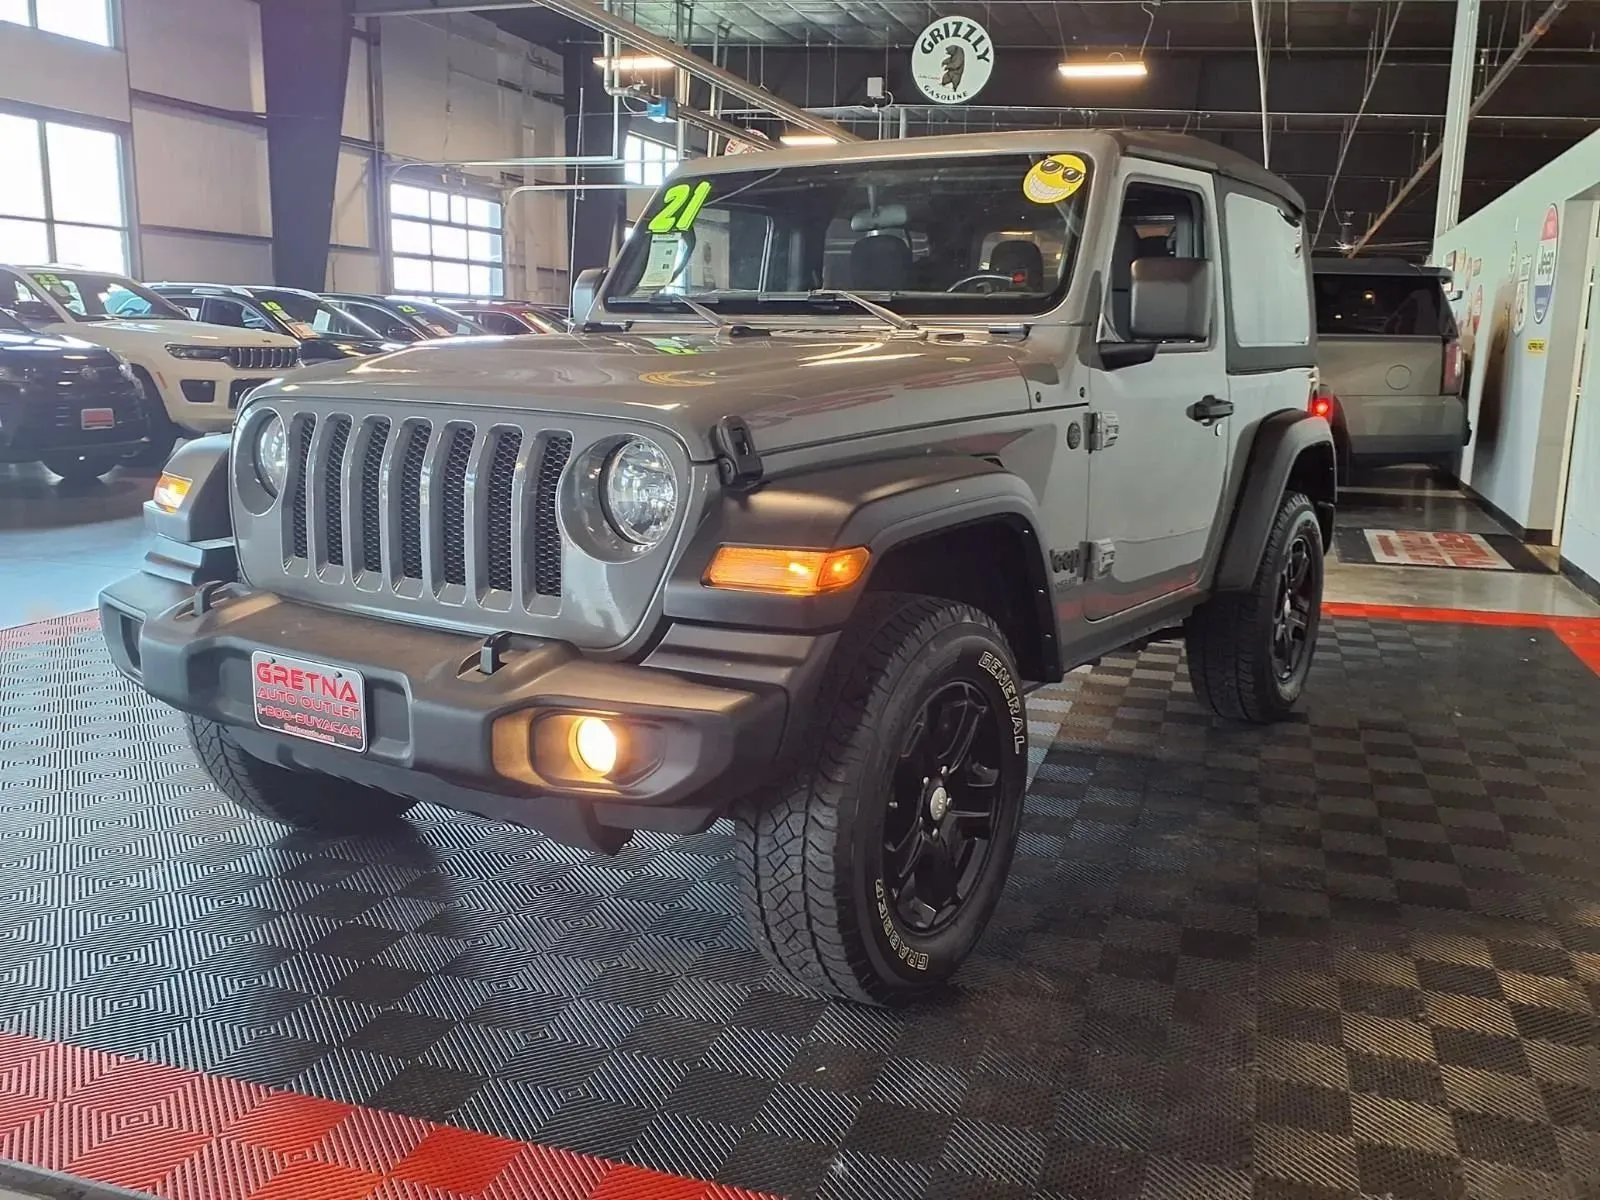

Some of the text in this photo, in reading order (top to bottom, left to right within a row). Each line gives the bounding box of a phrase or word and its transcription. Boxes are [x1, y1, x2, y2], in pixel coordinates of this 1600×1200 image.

[920, 21, 990, 63] GRIZZLY
[923, 84, 968, 101] GASOLINE
[647, 181, 712, 233] 21
[255, 662, 358, 704] GRETNA
[257, 687, 360, 720] AUTO OUTLET
[978, 650, 1025, 755] GENERAL
[875, 879, 929, 971] GRABBER
